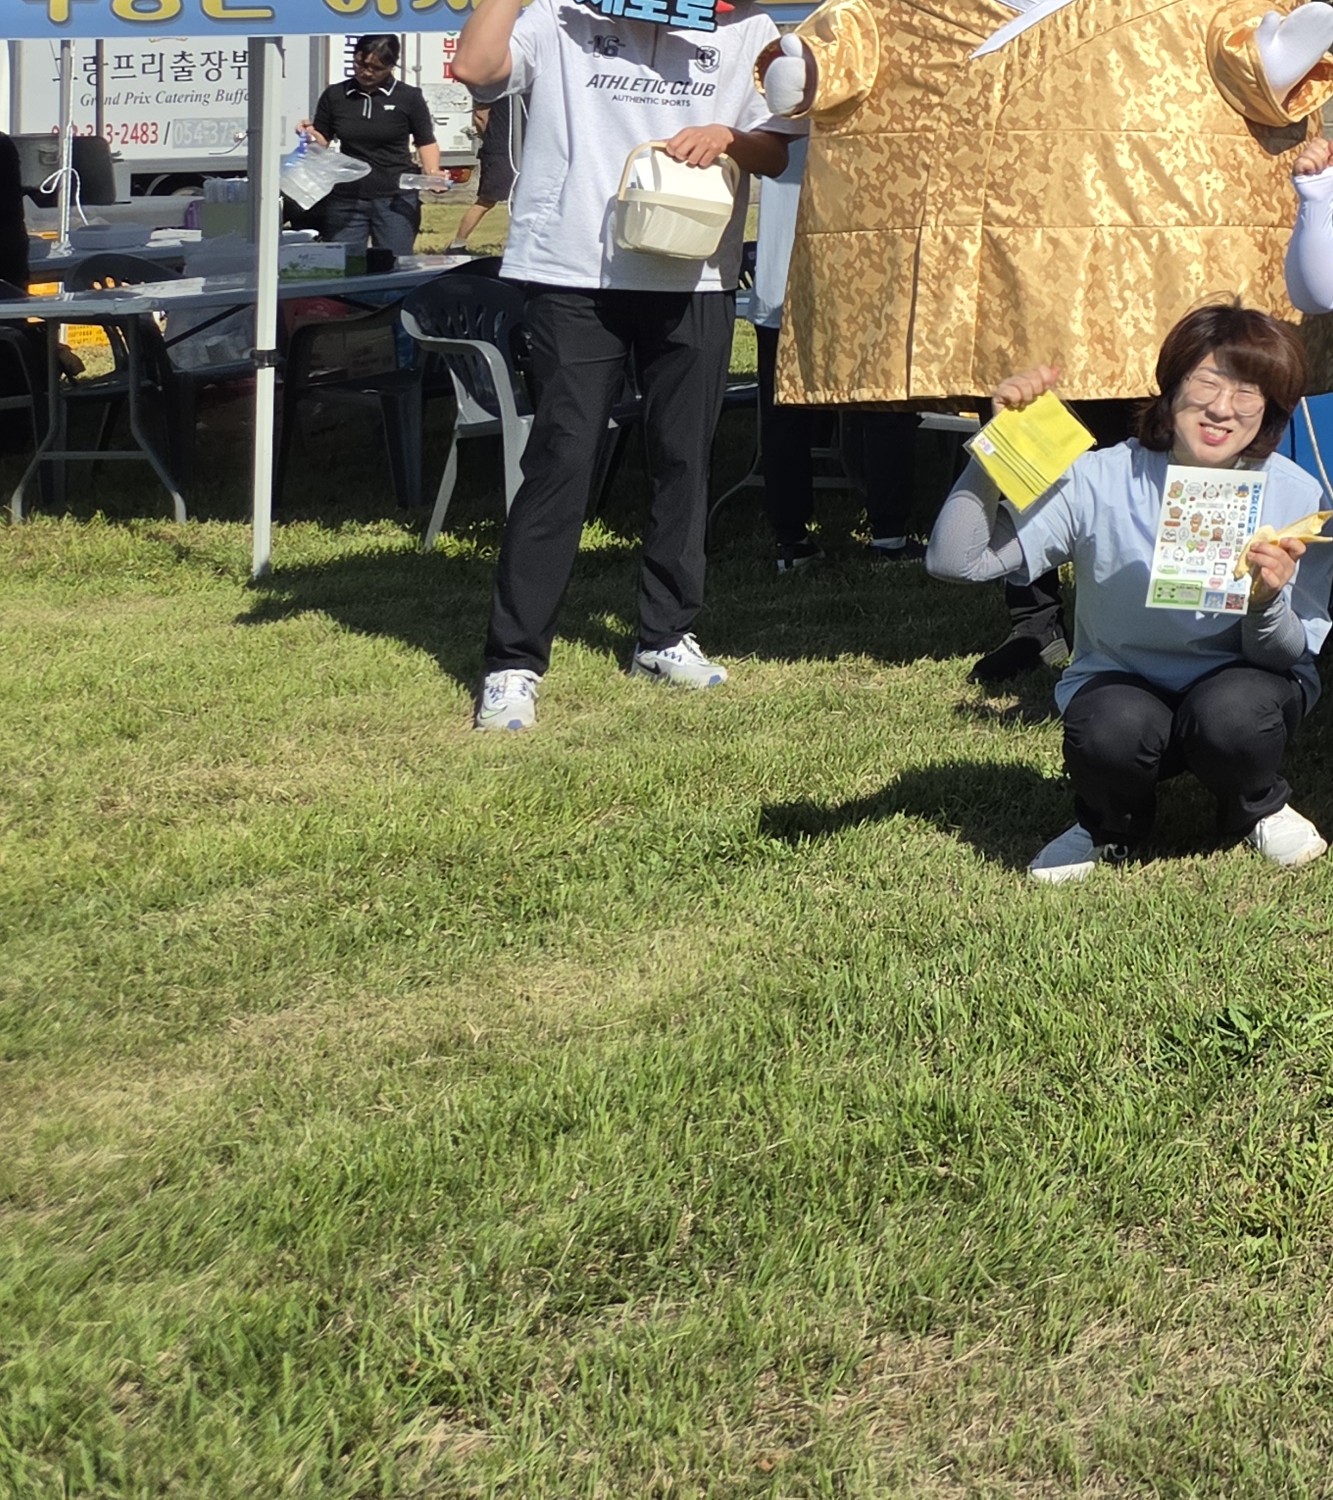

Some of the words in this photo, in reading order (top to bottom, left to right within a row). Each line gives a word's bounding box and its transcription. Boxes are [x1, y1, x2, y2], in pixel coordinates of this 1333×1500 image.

[592, 34, 620, 60] 16
[80, 92, 120, 106] Grnd
[124, 92, 152, 106] Prix
[155, 89, 211, 105] Catering
[215, 86, 249, 105] Buffe
[586, 73, 666, 95] ATHLETIC
[669, 80, 717, 98] CLUB
[611, 94, 660, 106] AUTHENTIC
[661, 97, 691, 108] SPORTS
